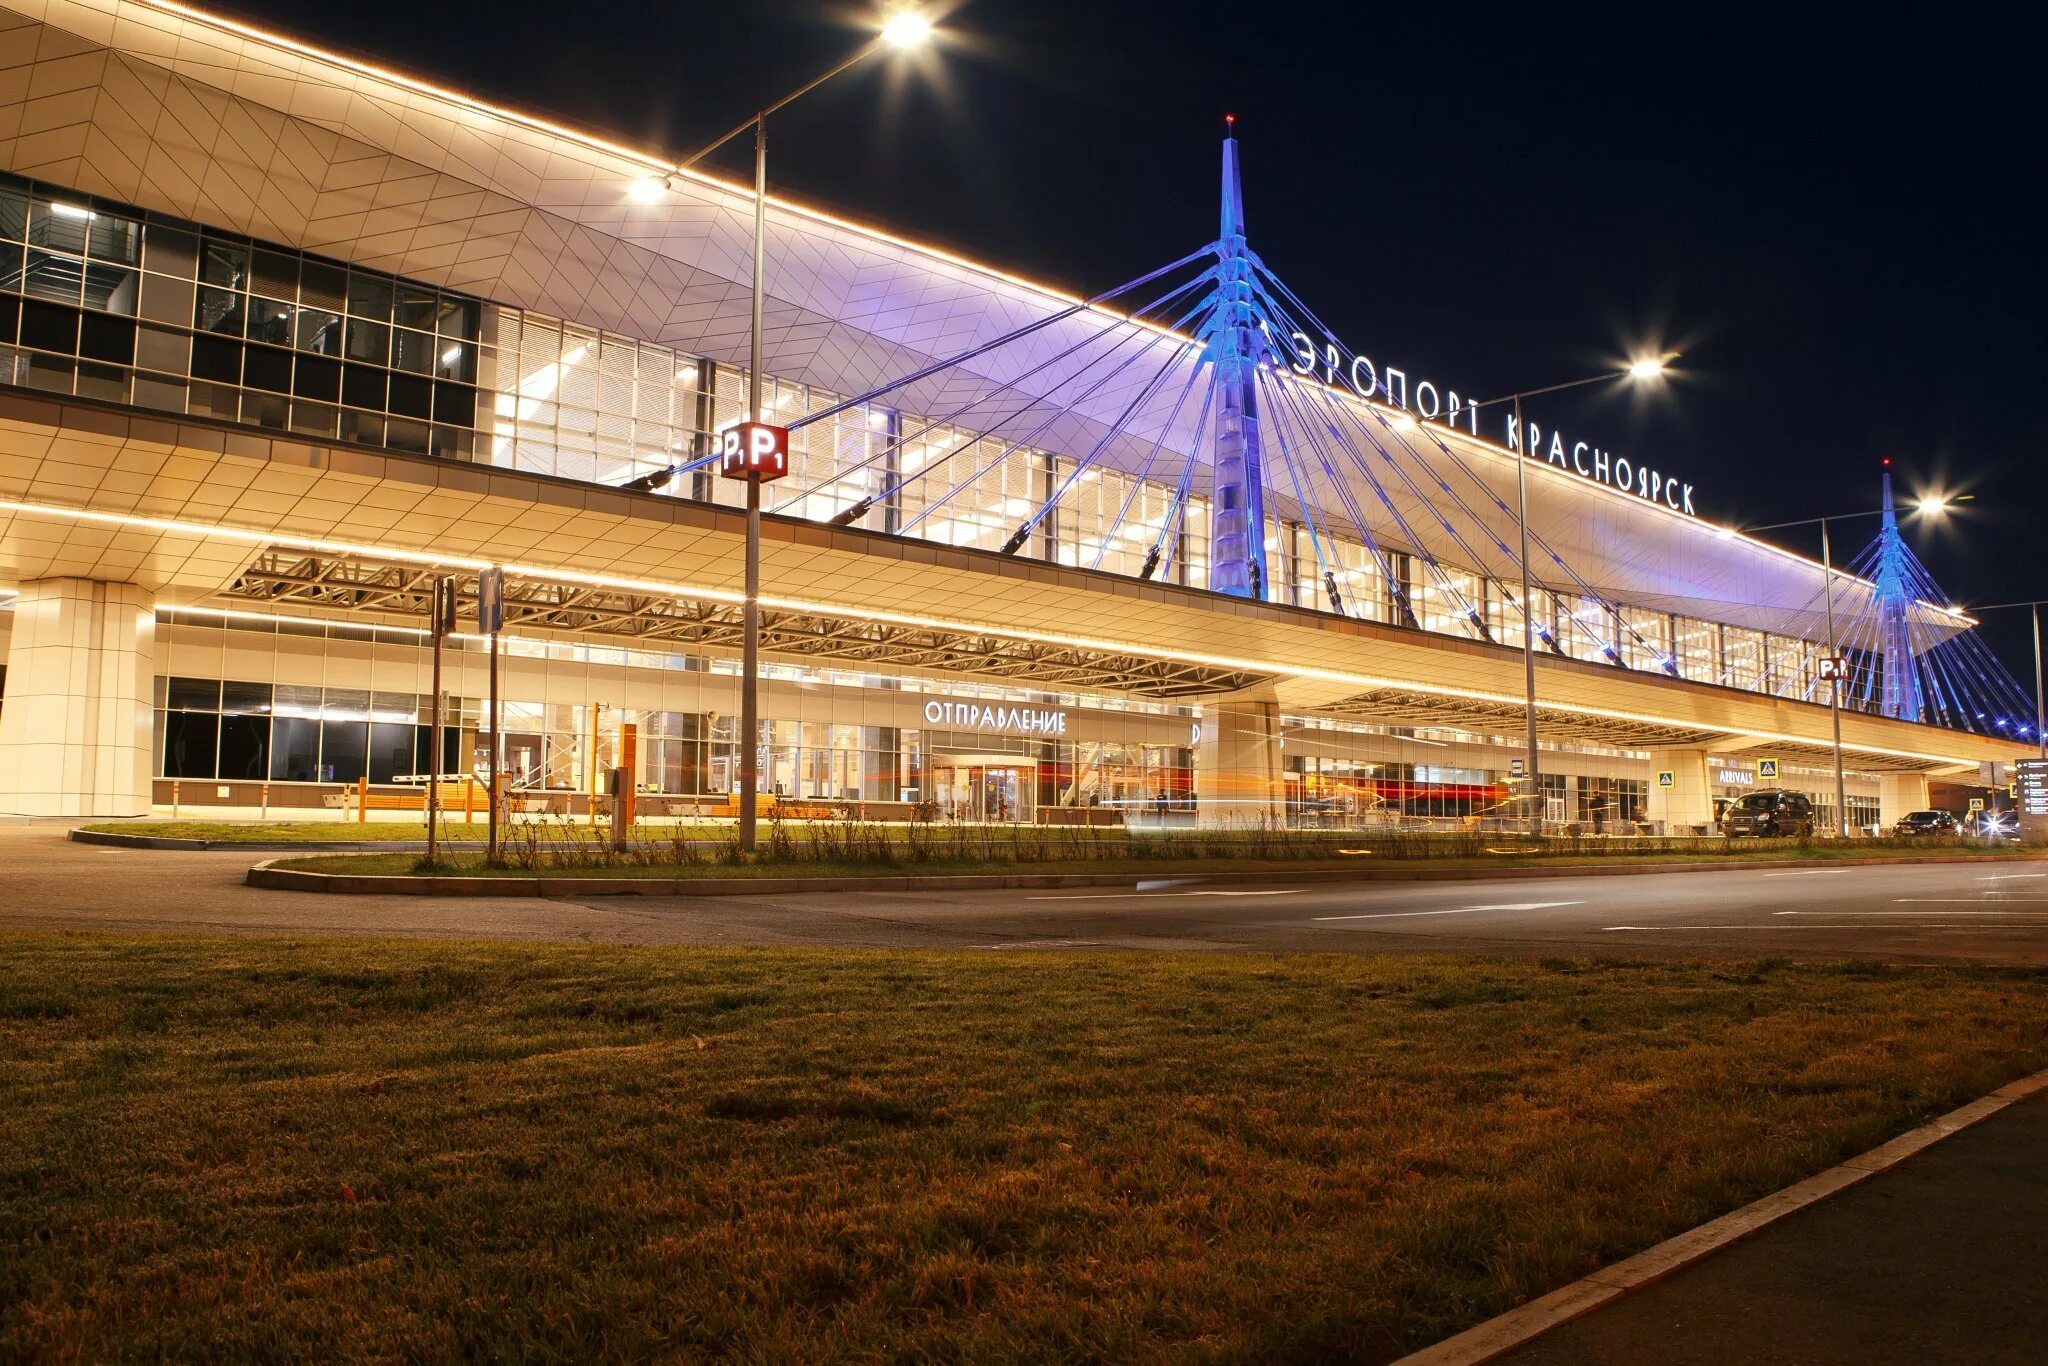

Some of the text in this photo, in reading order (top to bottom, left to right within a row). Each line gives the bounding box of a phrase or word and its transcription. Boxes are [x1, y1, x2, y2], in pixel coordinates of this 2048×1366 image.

[1260, 319, 1696, 516] ЭРОПОРТ КРАСНОЯРСК
[750, 427, 783, 469] P1
[924, 700, 1067, 734] ОТПРАВЛЕНИЕ
[1719, 770, 1753, 785] ARRIVALS
